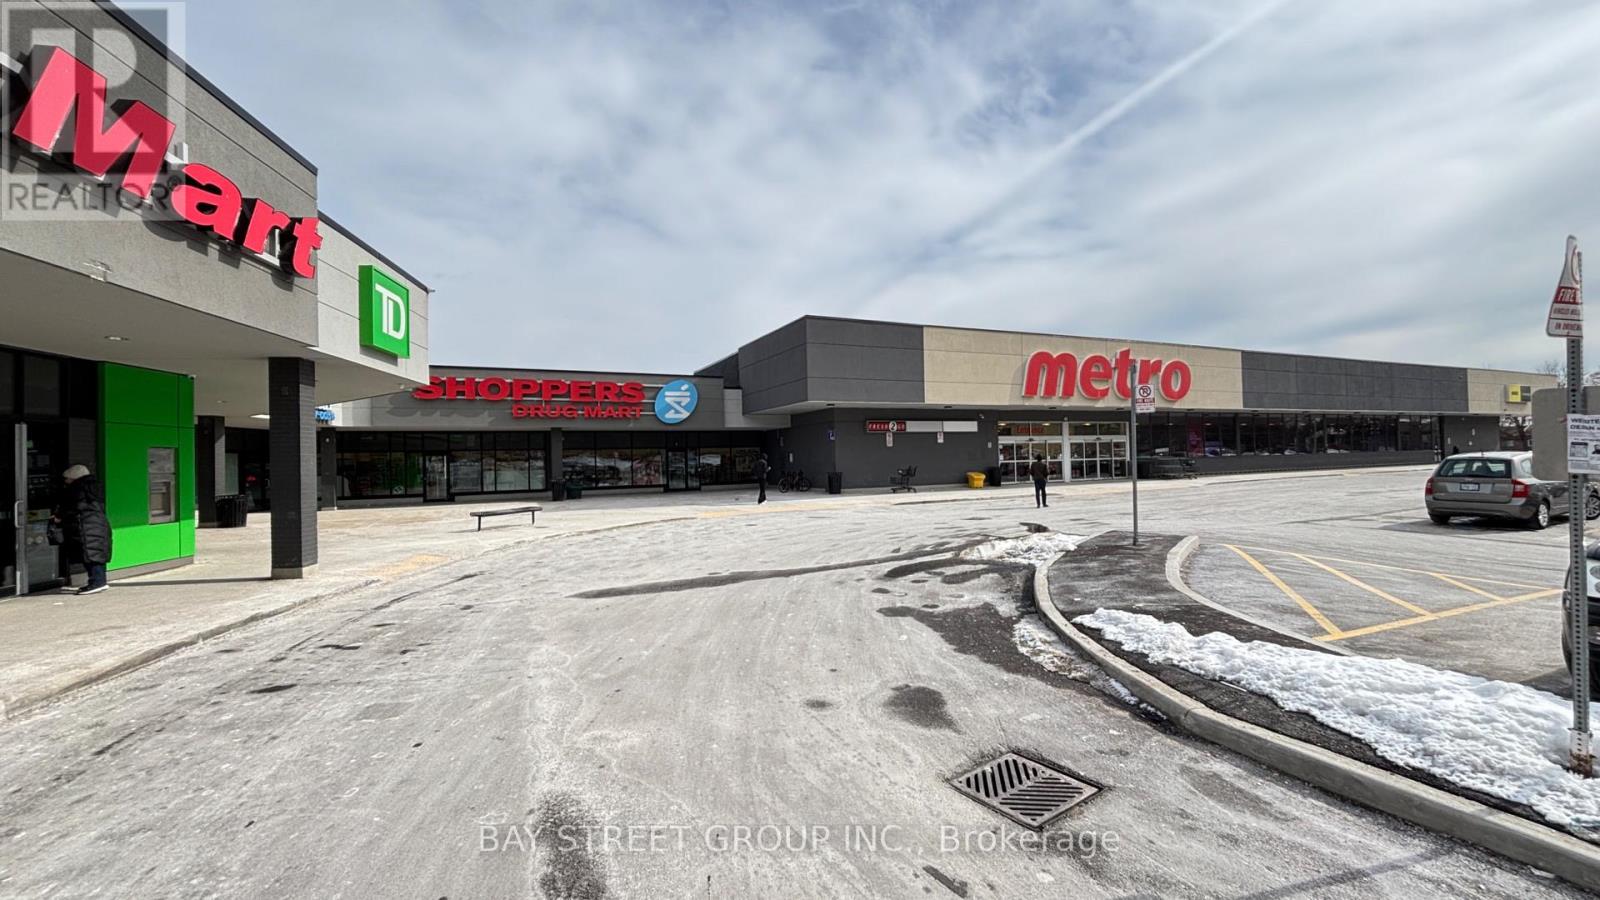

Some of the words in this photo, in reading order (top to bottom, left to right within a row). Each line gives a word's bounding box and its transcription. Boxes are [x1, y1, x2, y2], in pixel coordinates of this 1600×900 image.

[13, 45, 322, 279] Mart
[375, 283, 405, 339] TD
[412, 376, 646, 403] SHOPPERS
[1022, 348, 1192, 401] metro
[512, 404, 578, 419] DRUG
[584, 405, 643, 419] MART
